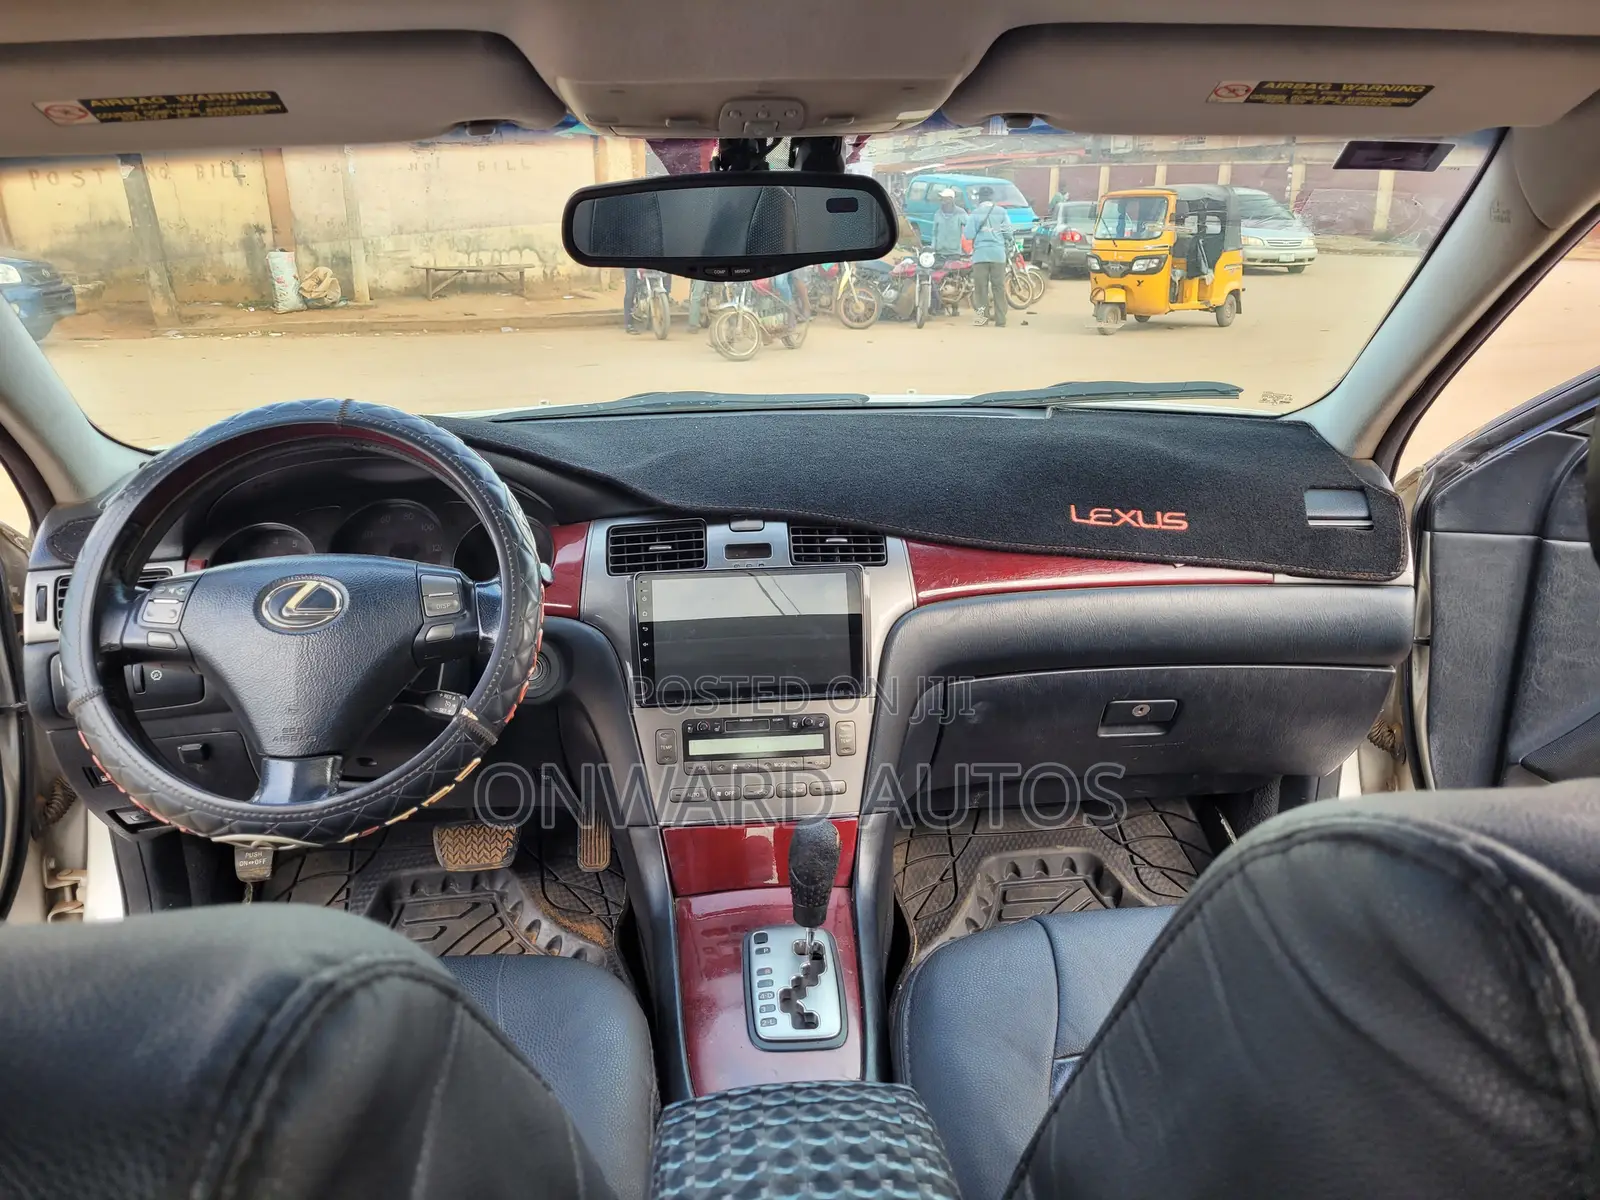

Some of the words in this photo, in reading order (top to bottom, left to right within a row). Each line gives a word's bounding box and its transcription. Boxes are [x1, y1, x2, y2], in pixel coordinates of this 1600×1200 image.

[1263, 82, 1333, 91] AIRBAG
[1342, 83, 1426, 93] WARNING
[91, 96, 167, 107] AIRBAG
[175, 91, 272, 102] WARNING
[27, 168, 105, 190] POST
[1070, 504, 1189, 531] LEXUS
[436, 602, 451, 610] DISP
[245, 851, 263, 859] PUSH
